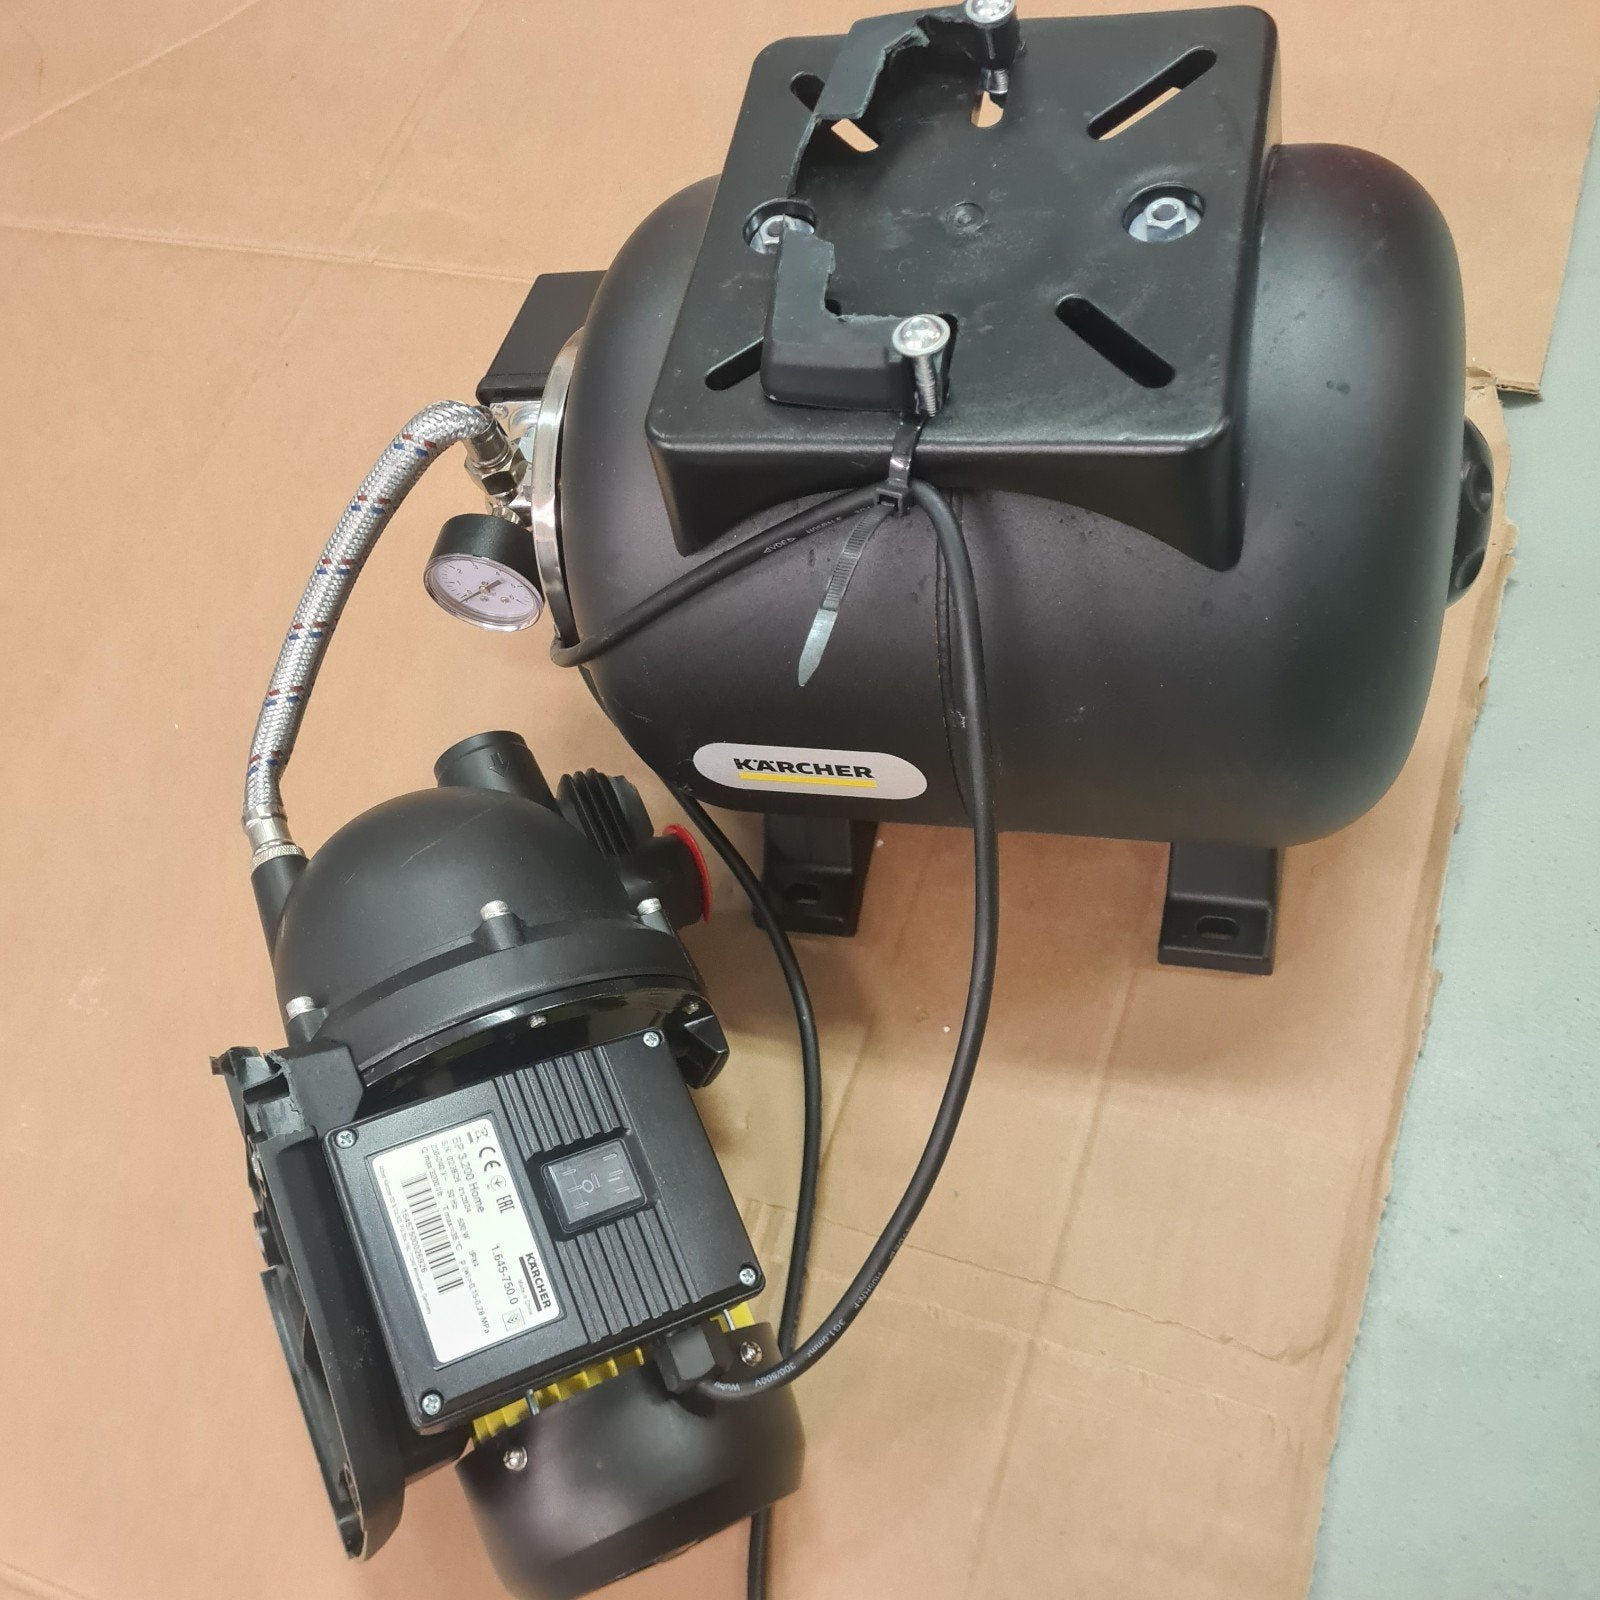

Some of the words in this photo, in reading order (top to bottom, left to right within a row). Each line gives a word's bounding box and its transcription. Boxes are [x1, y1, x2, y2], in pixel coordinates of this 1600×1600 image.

[733, 758, 875, 779] KÄRCHER
[450, 1135, 465, 1152] BP
[456, 1151, 475, 1182] 3.200
[467, 1180, 488, 1214] Home
[489, 1244, 520, 1305] 1.645-750.0
[524, 1252, 552, 1309] KÄRCHER
[479, 1315, 491, 1334] MPa
